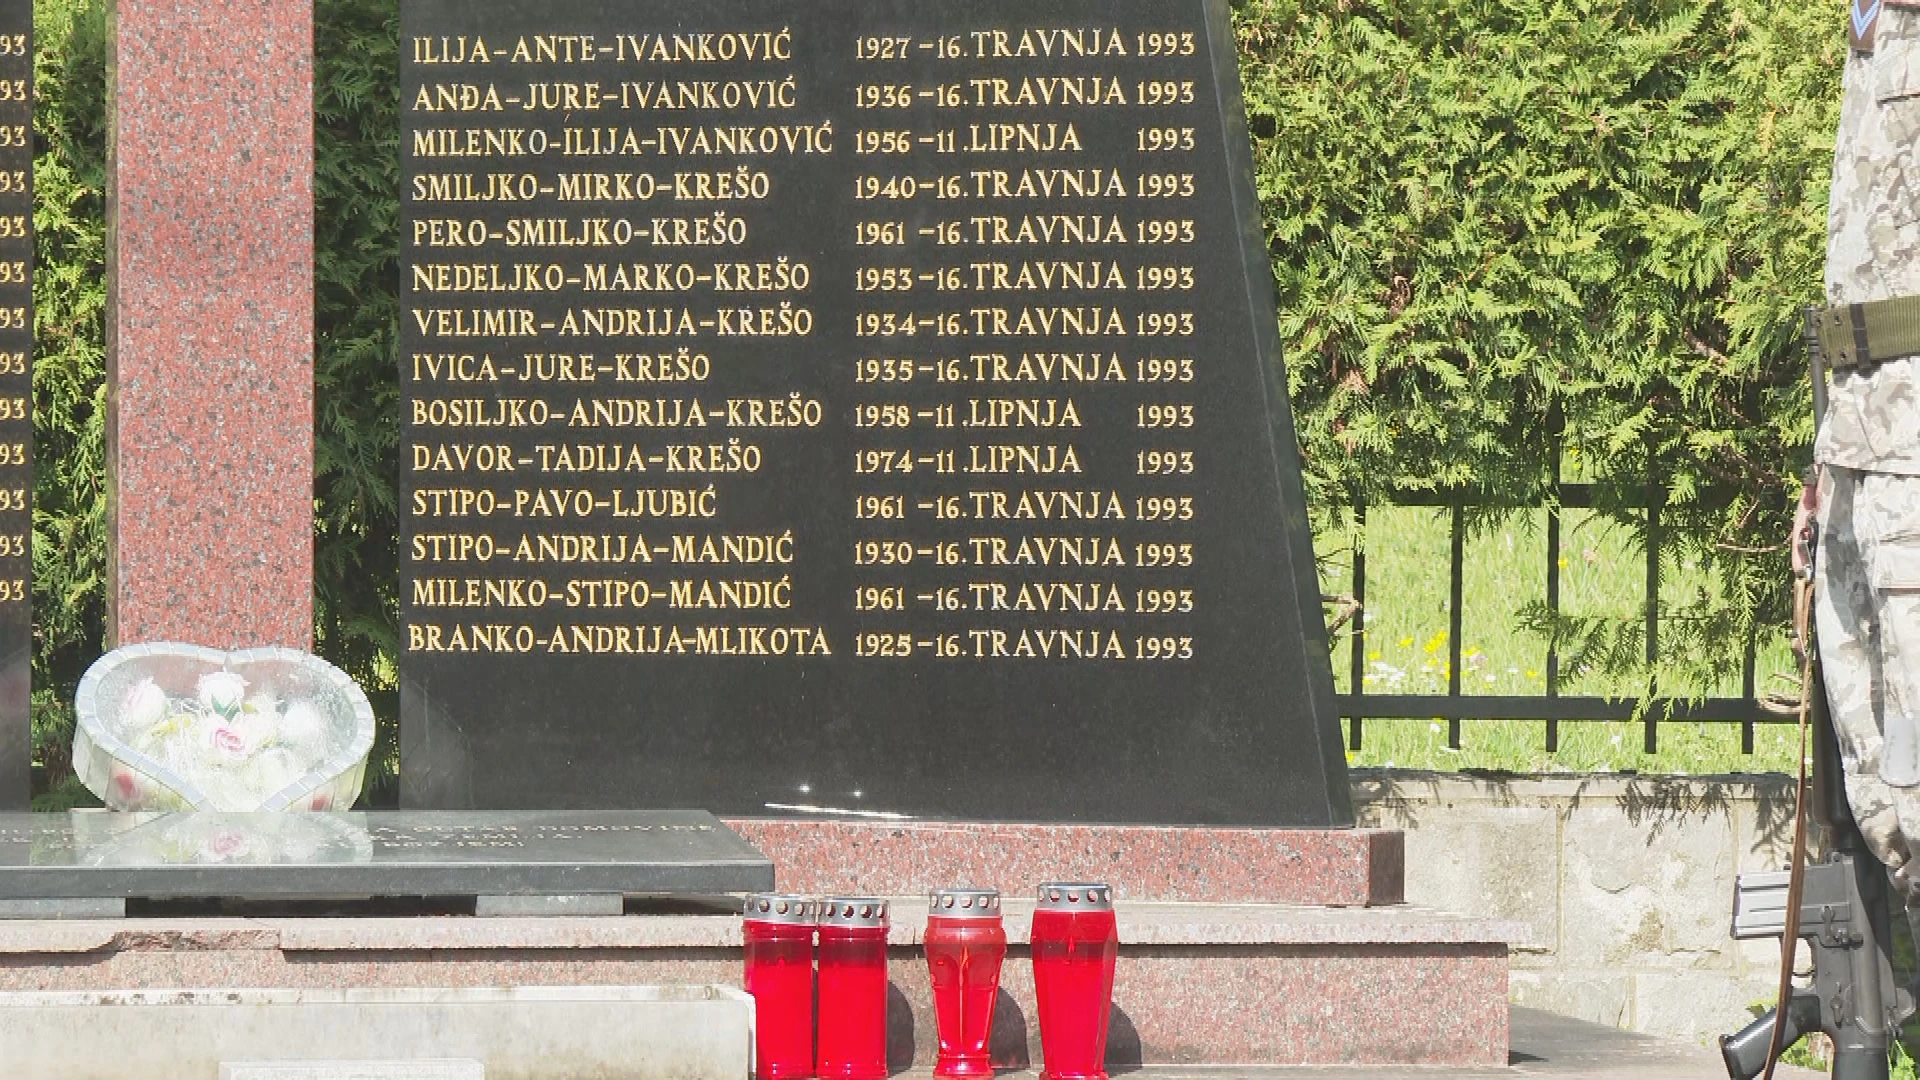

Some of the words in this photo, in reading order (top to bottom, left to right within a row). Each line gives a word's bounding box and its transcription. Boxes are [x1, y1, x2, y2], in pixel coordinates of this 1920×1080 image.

[413, 25, 791, 65] ILIJA-ANTE-IVANKOVIĆ
[1137, 31, 1195, 57] 1993
[412, 75, 796, 111] ANĐA-JURE-IVANKOVIĆ
[1137, 81, 1195, 105] 1993
[1137, 127, 1195, 151] 1993
[412, 165, 770, 201] SMILJKO-MIRKO-KREŠO
[1137, 173, 1195, 199] 1993
[412, 209, 747, 247] PERO-SMILJKO-KREŠO
[1137, 219, 1195, 245] 1993
[411, 255, 810, 293] NEDELJKO-MARKO-KREŠO
[1137, 265, 1194, 291] 1993
[411, 301, 813, 337] VELIMIR-ANDRIJA-KREŠO
[1136, 311, 1194, 337] 1993
[412, 347, 710, 383] IVICA-JURE-KREŠO
[1137, 359, 1194, 383] 1993
[411, 391, 822, 427] BOSILJKO-ANDRIJA-KREŠO
[1137, 403, 1194, 429] 1993
[412, 437, 761, 473] DAVOR-TADIJA-KREŠO
[1136, 449, 1194, 475] 1993
[412, 483, 716, 519] STIPO-PAVO-LJUBIĆ
[1136, 497, 1194, 521] 1993
[411, 529, 794, 563] STIPO-ANDRIJA-MANDIĆ
[1135, 543, 1193, 567] 1993
[412, 573, 791, 609] MILENKO-STIPO-MANDIĆ
[1135, 589, 1194, 613] 1993
[407, 623, 832, 655] BRANKO-ANDRIJA-MLIKOTA
[1135, 635, 1193, 659] 1993
